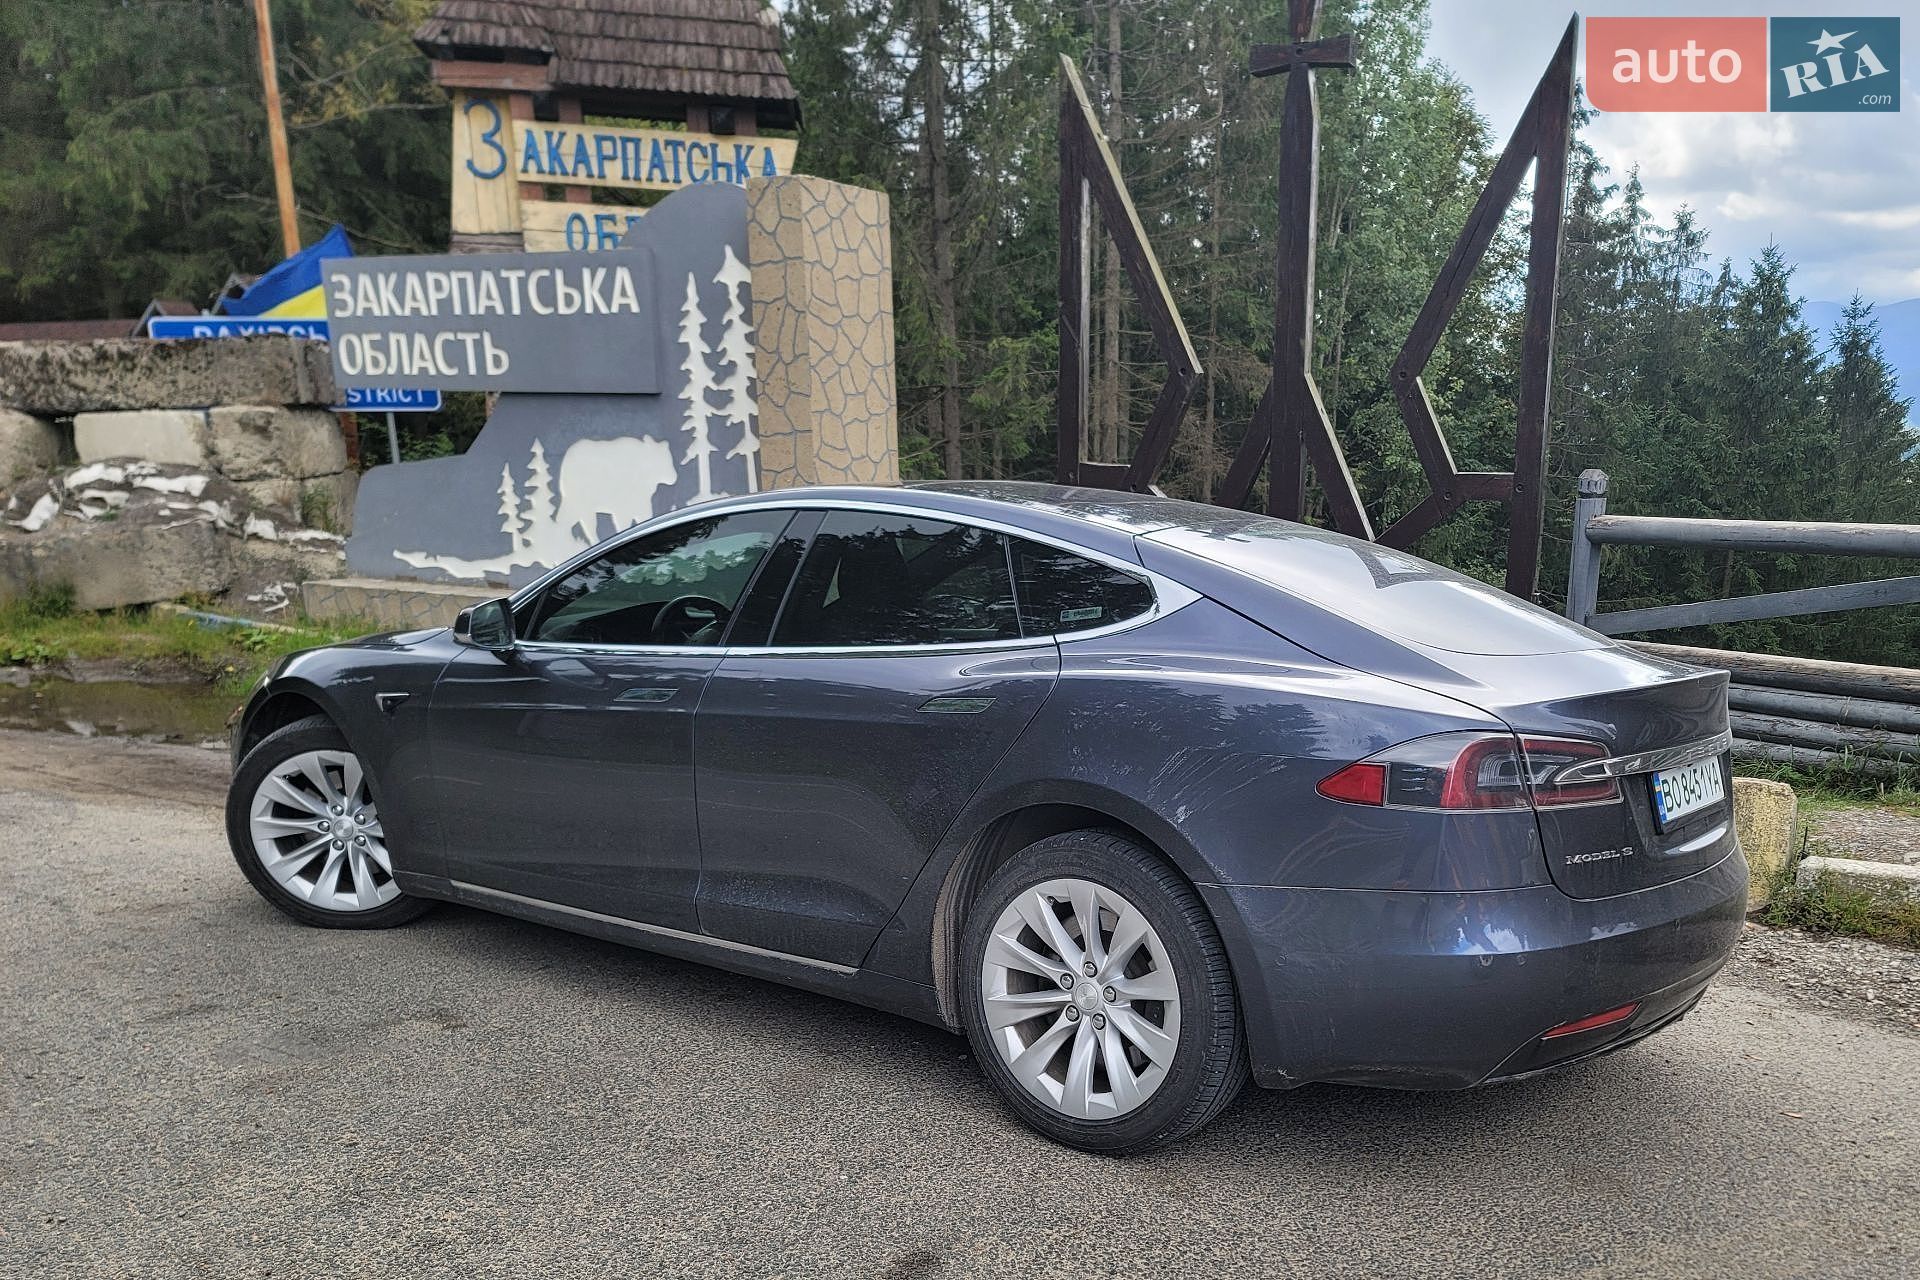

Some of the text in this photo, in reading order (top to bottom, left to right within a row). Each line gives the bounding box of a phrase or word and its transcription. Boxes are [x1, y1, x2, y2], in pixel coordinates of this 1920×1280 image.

[566, 212, 641, 253] ОБ
[331, 266, 641, 317] ЗАКАРПАТСЬКА
[338, 330, 510, 376] ОБЛАСТЬ
[1565, 846, 1634, 865] MODEL S
